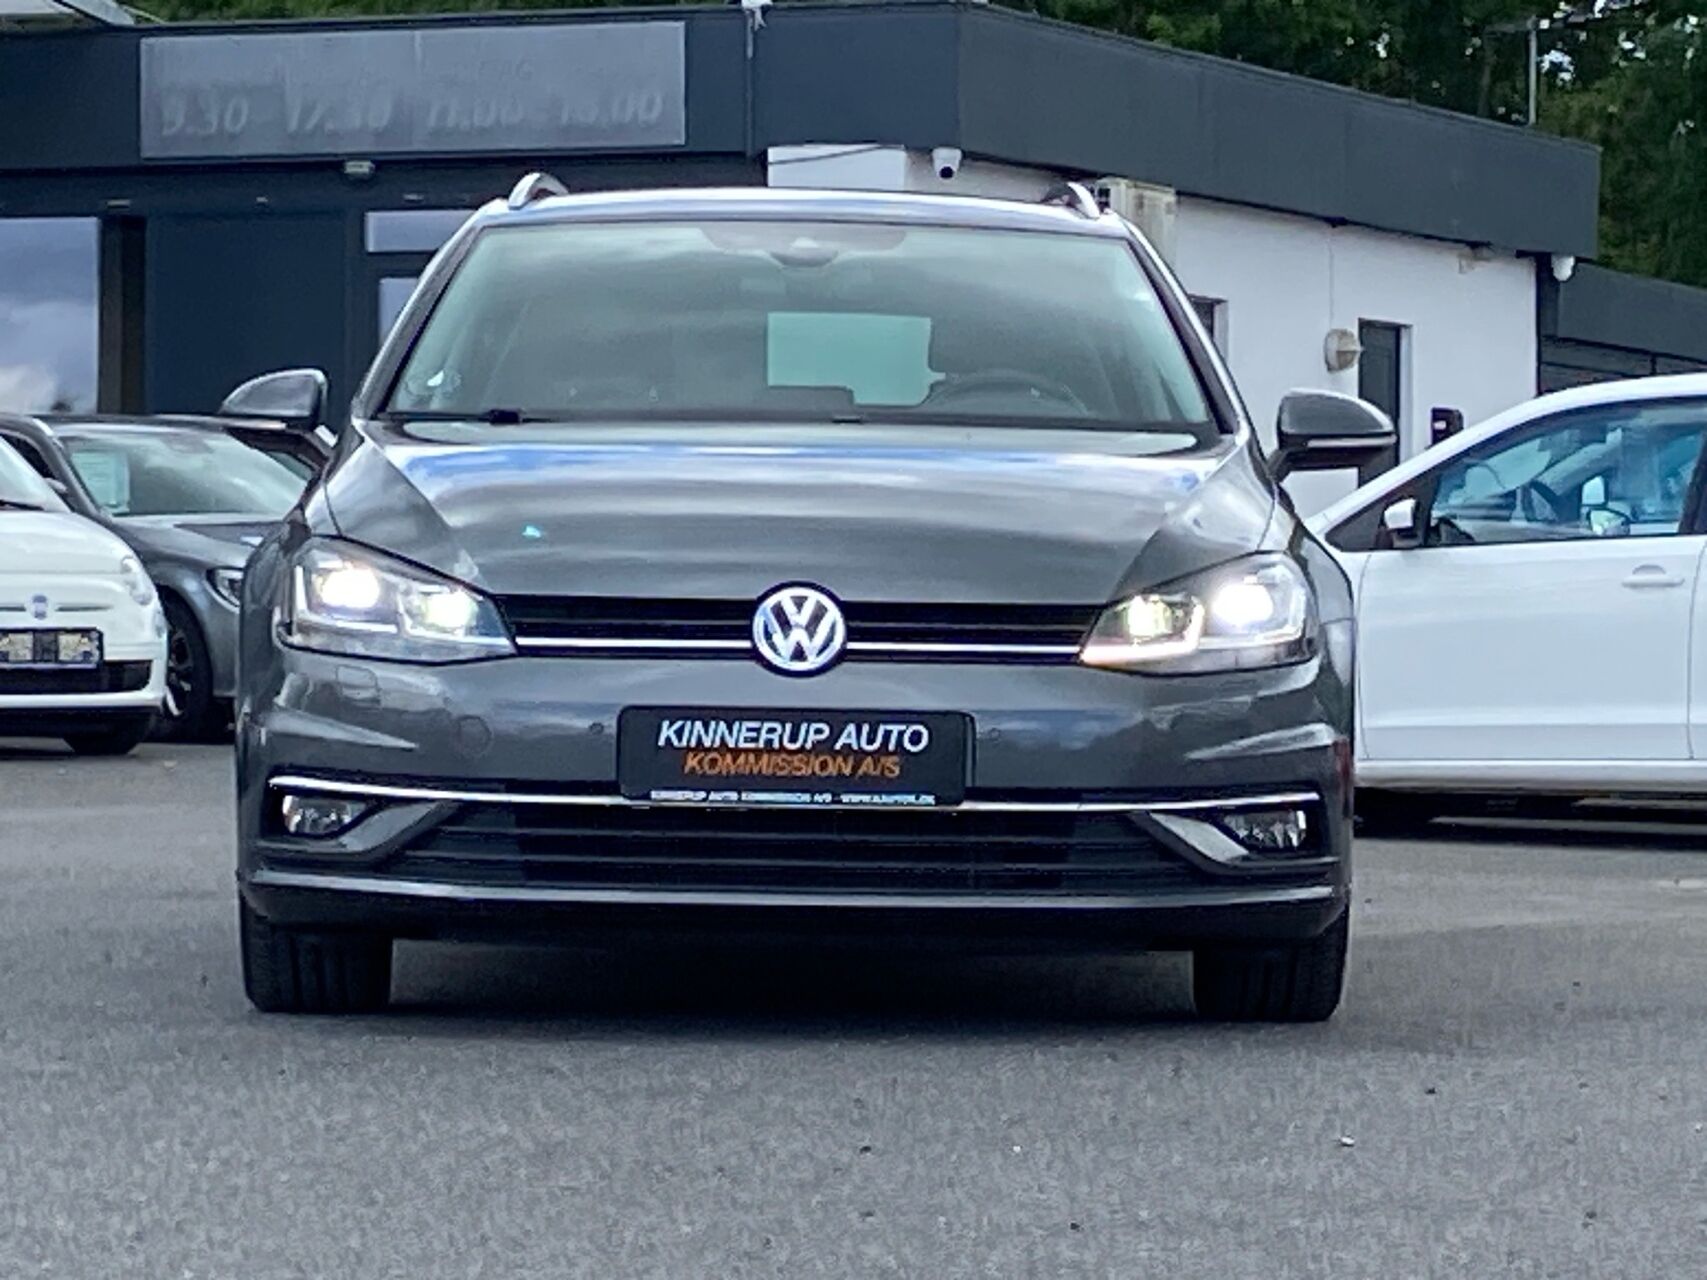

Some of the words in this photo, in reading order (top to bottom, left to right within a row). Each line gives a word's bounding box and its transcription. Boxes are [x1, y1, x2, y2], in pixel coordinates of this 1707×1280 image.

[754, 588, 845, 671] VW
[657, 719, 830, 749] KINNERUP
[834, 723, 929, 752] AUTO
[684, 752, 852, 776] KOMMISSION
[857, 755, 901, 777] A/S
